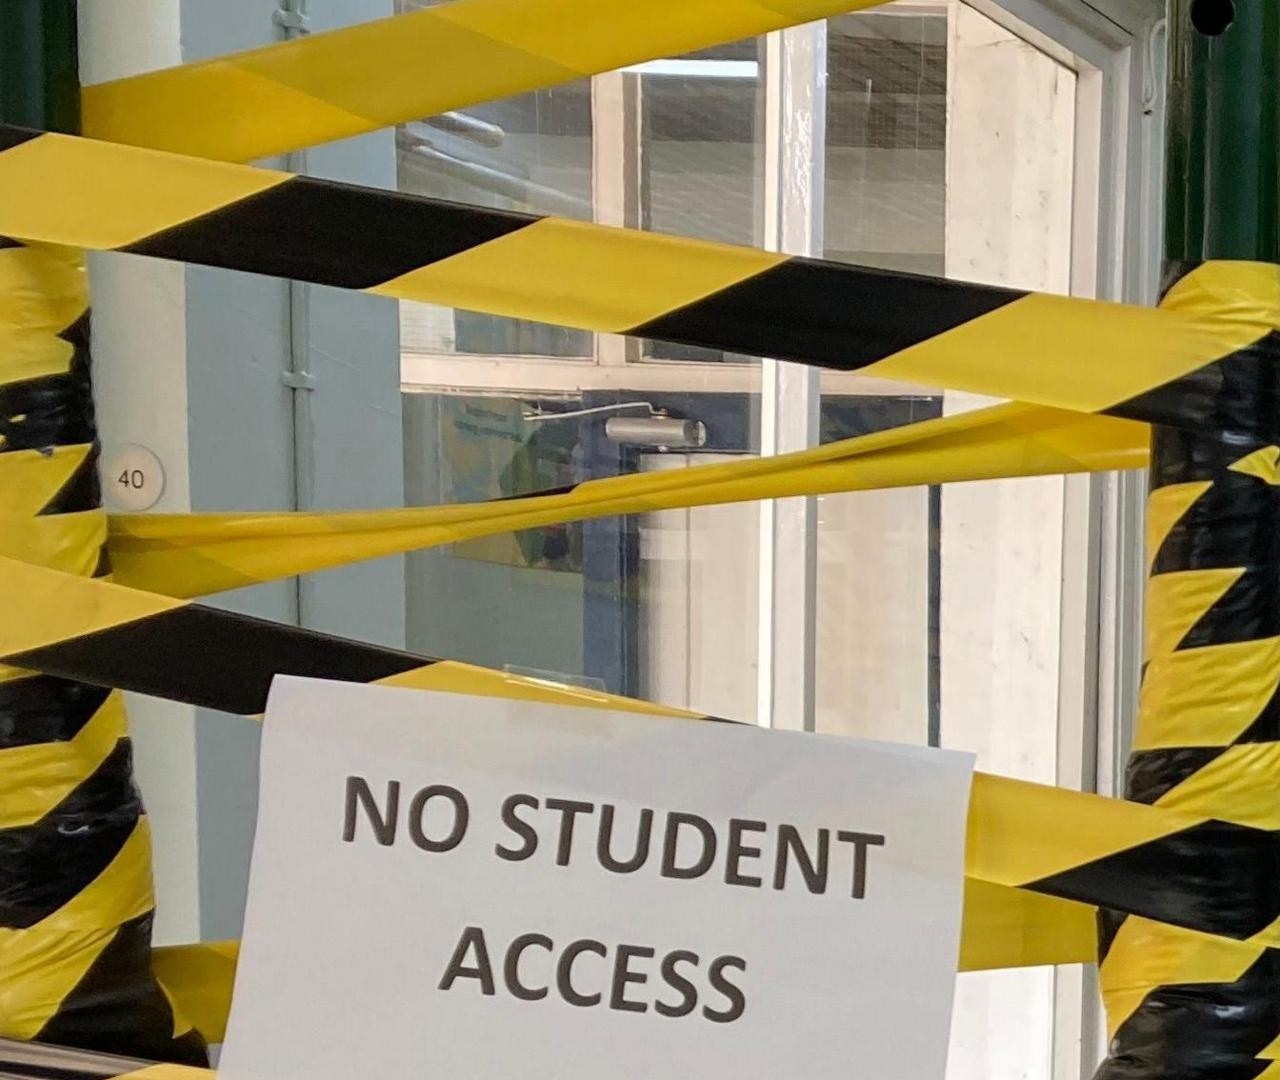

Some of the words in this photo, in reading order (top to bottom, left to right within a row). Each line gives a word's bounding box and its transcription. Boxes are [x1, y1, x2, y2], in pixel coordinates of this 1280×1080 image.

[118, 469, 144, 489] 40
[342, 775, 470, 853] NO
[494, 793, 886, 900] STUDENT
[437, 926, 747, 1024] ACCESS
